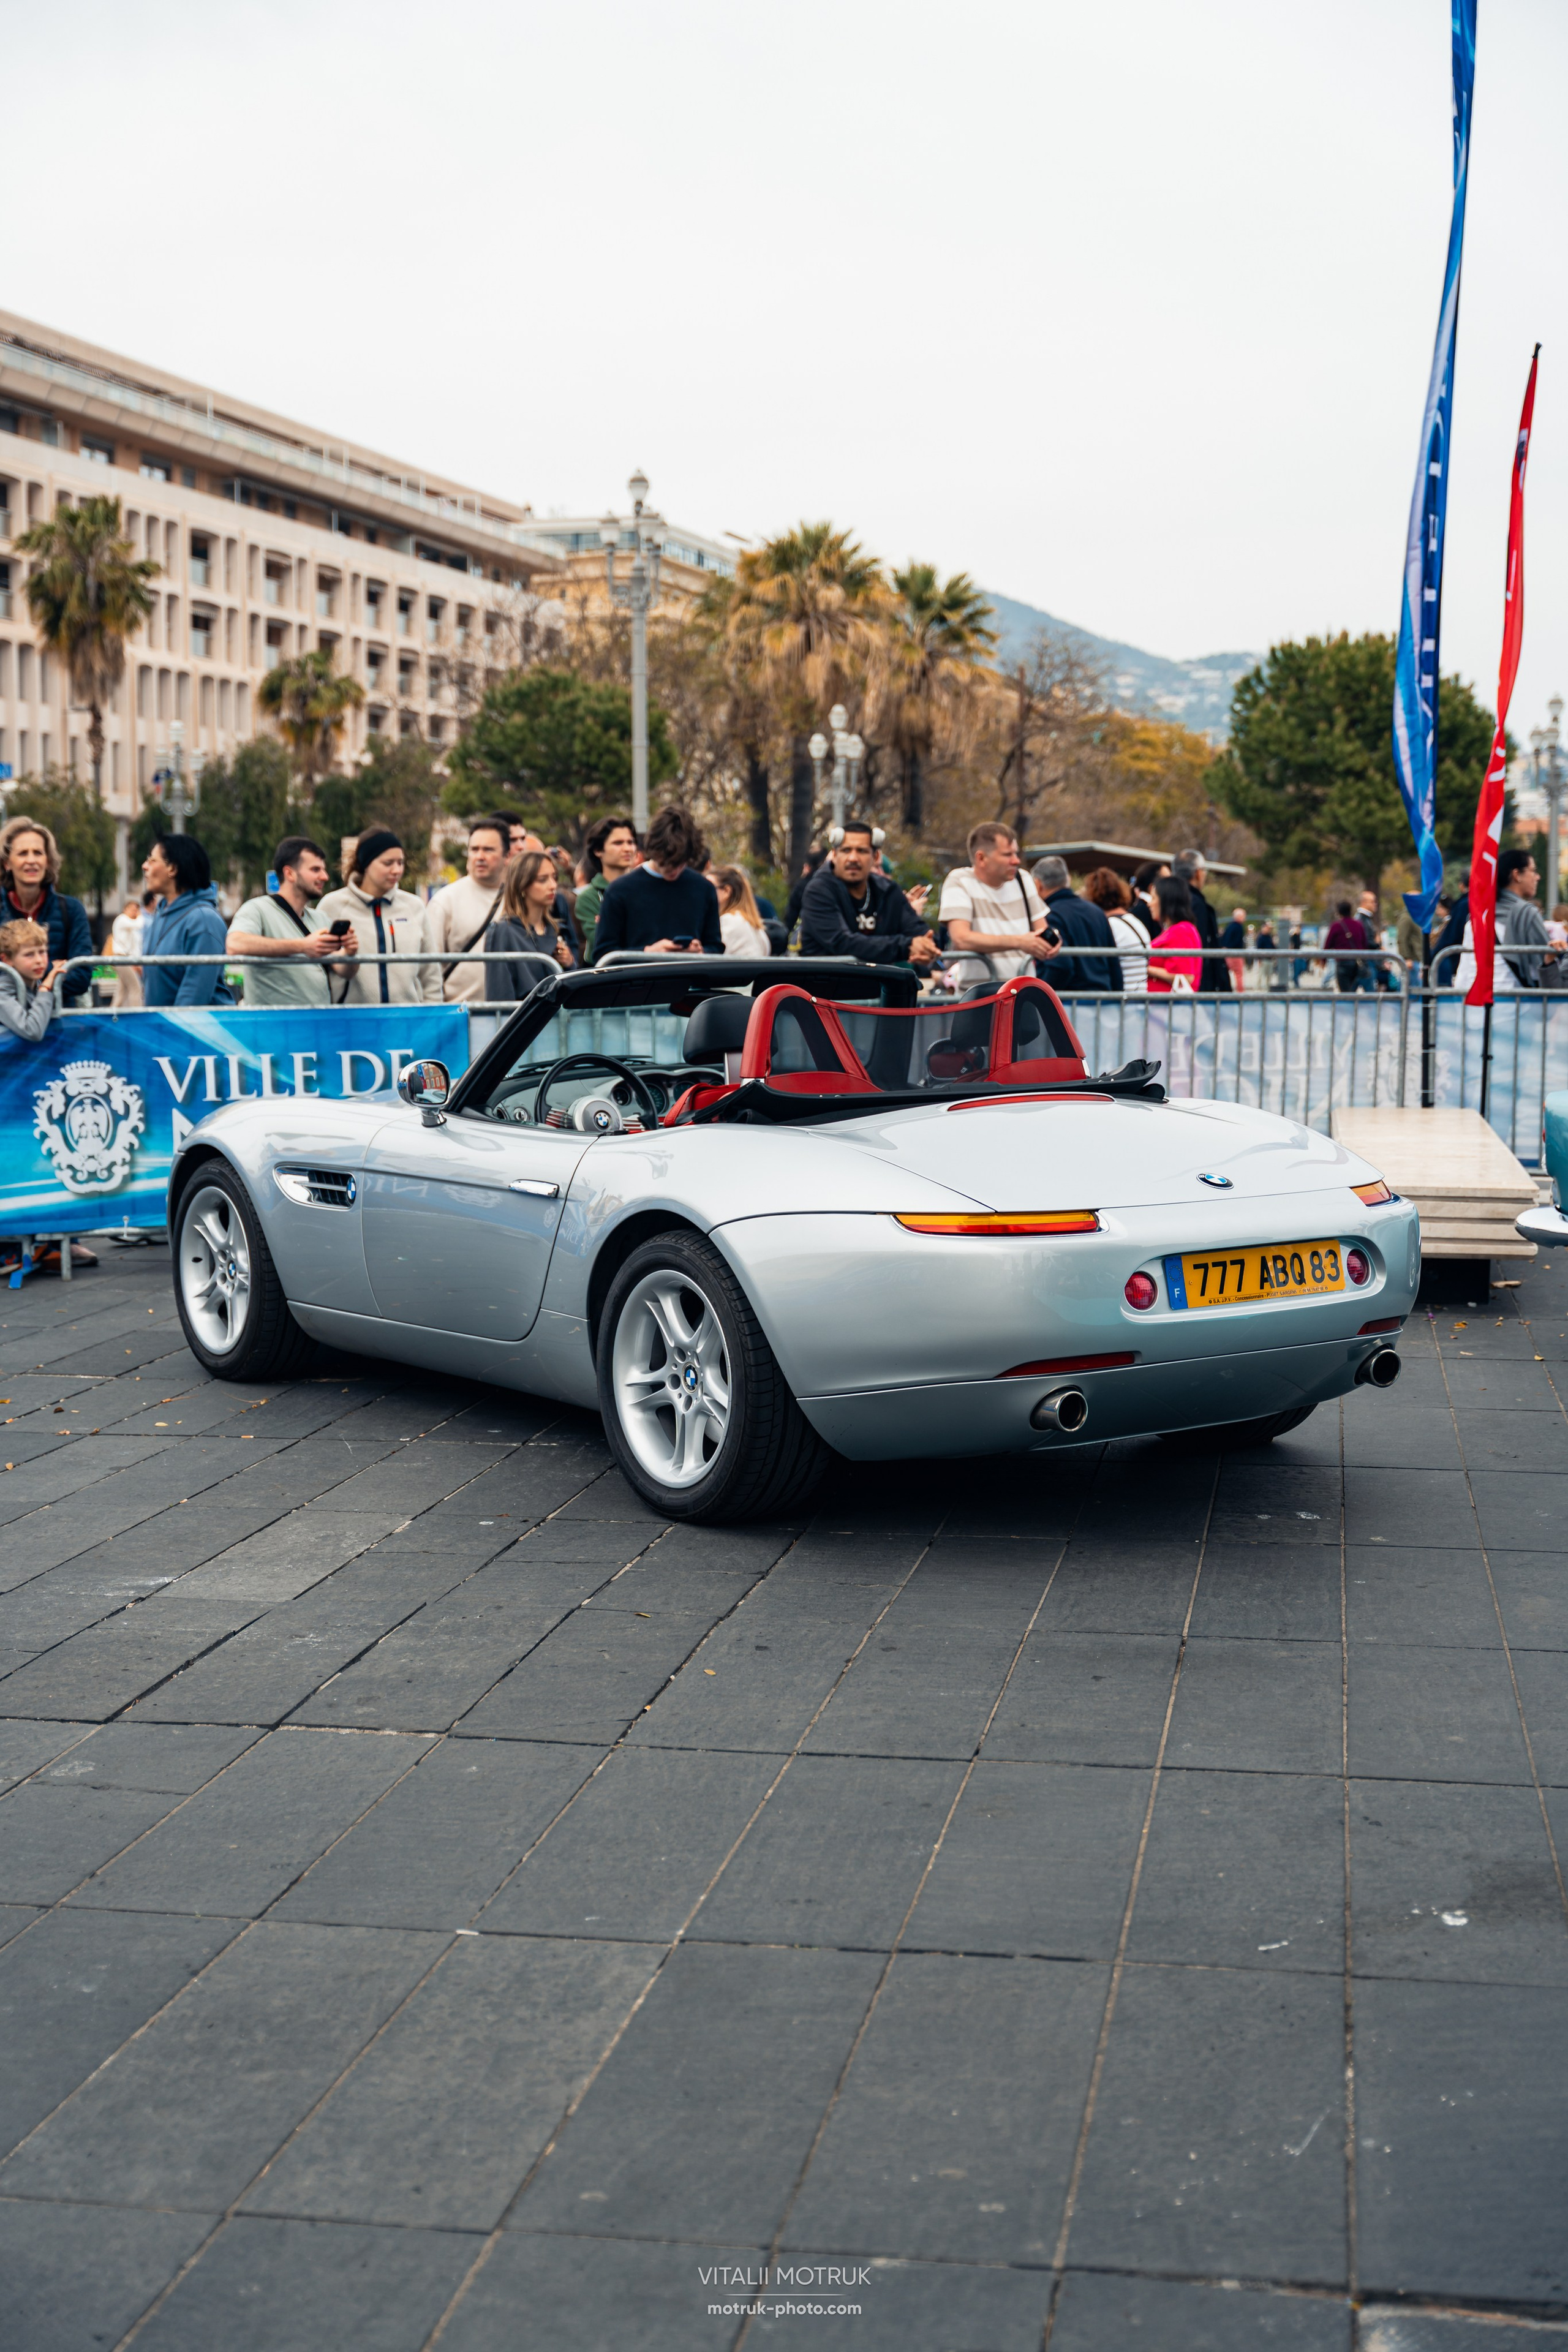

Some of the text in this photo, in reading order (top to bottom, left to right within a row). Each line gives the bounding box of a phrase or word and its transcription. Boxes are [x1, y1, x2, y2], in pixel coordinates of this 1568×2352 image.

[152, 1052, 320, 1102] VILLE
[1174, 1287, 1180, 1298] F
[1193, 1249, 1341, 1297] 777 ABQ 83
